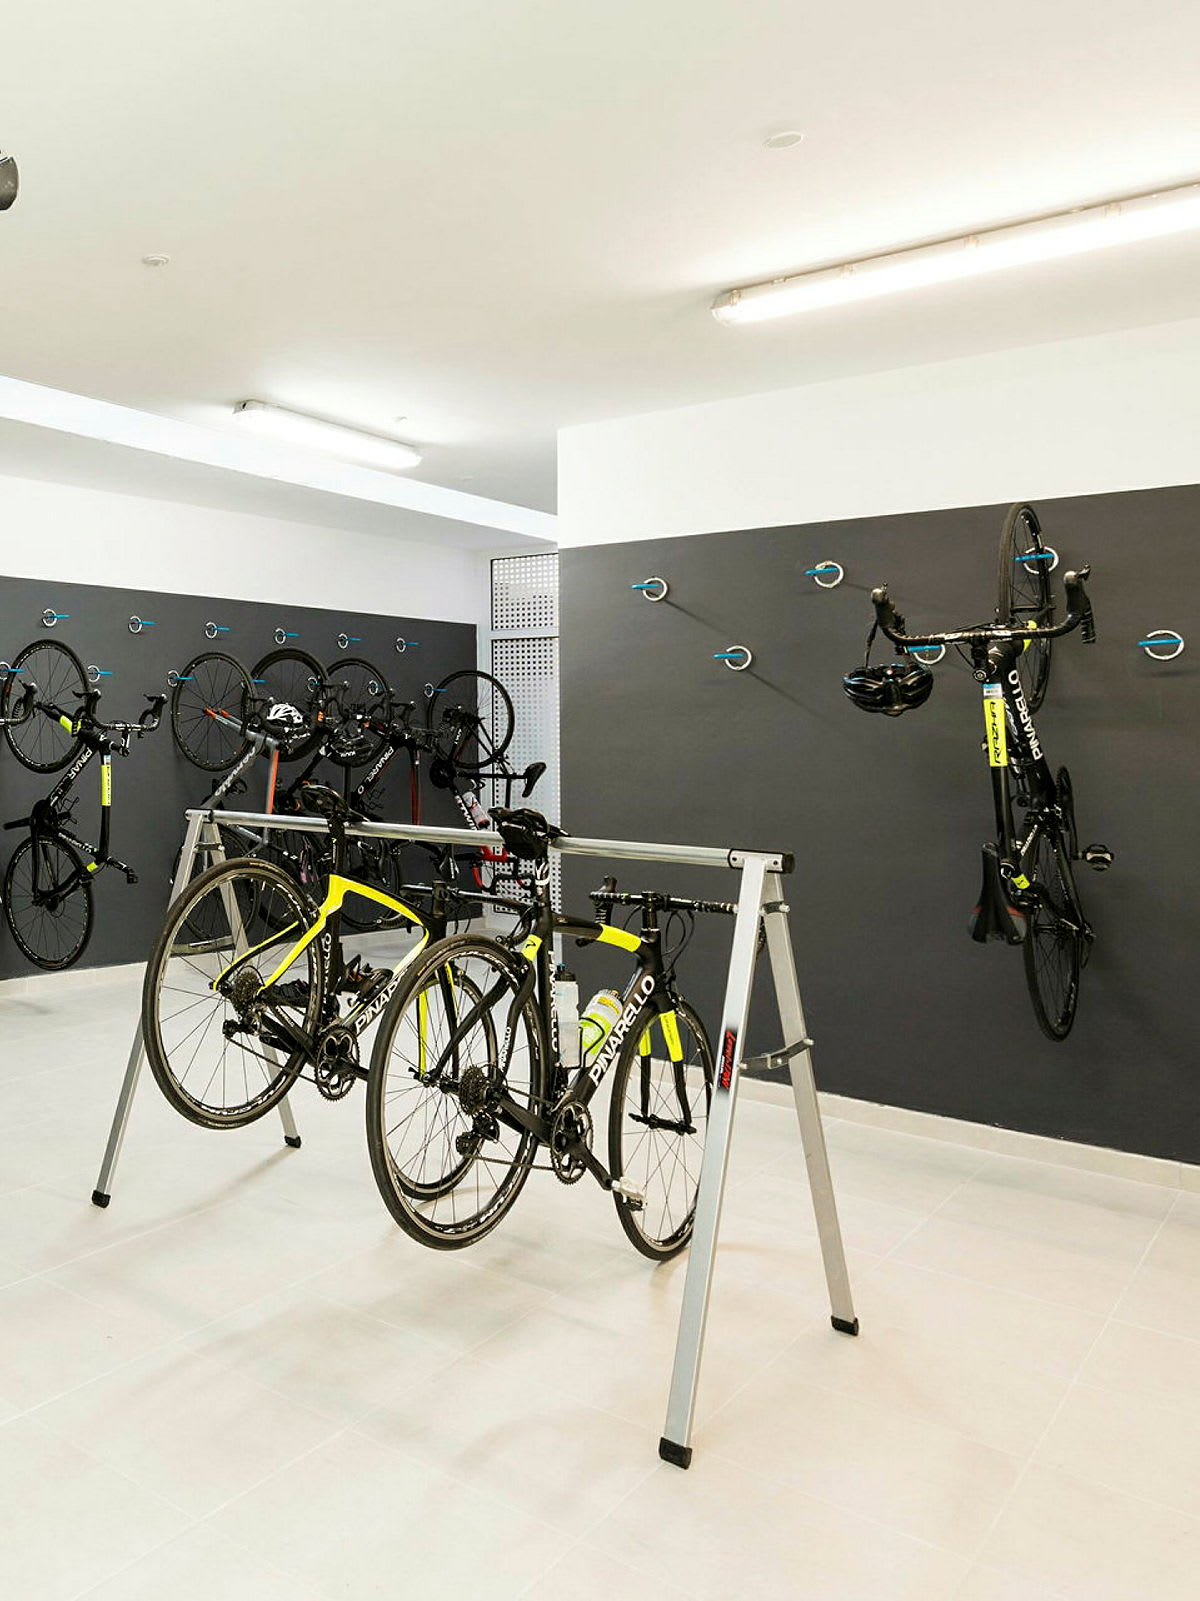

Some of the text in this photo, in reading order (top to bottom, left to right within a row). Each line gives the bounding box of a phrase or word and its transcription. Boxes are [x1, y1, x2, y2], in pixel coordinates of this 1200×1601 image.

[1008, 669, 1044, 761] PINARELLO
[357, 746, 394, 794] PINARELO
[588, 974, 656, 1087] PINARELLO
